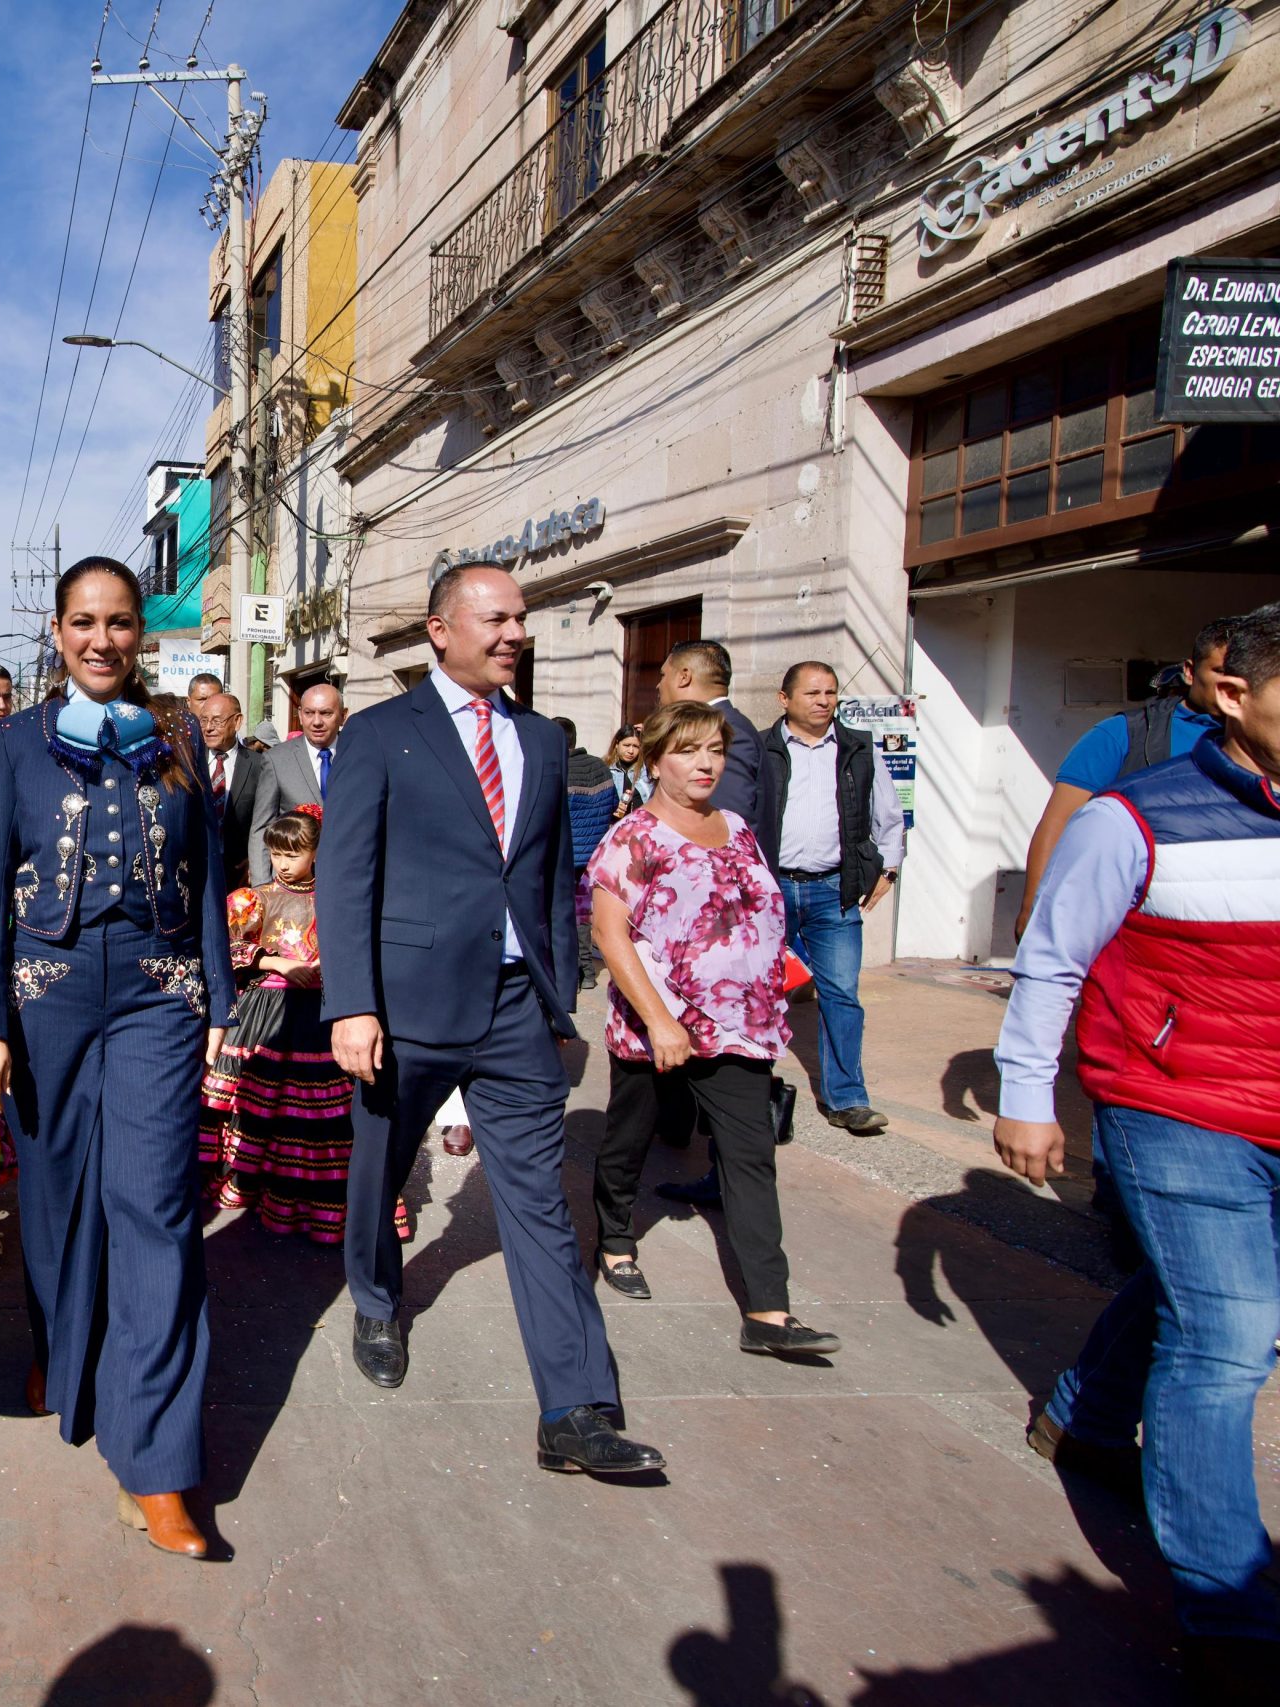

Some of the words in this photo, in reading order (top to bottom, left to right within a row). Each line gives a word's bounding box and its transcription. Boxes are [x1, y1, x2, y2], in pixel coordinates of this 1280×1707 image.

[1002, 162, 1080, 213] EXCELENCIA
[1037, 191, 1056, 209] EN
[1056, 159, 1116, 207] CALIDAD
[1182, 311, 1240, 336] CERDA
[1184, 375, 1253, 398] CIRUGIA
[459, 534, 518, 565] Banco
[518, 497, 607, 553] Azteca
[241, 633, 281, 641] ESTACIONARSE
[247, 627, 277, 635] PROHIBIDO
[172, 652, 211, 662] BAÑOS
[162, 665, 220, 676] PÚBLICOS
